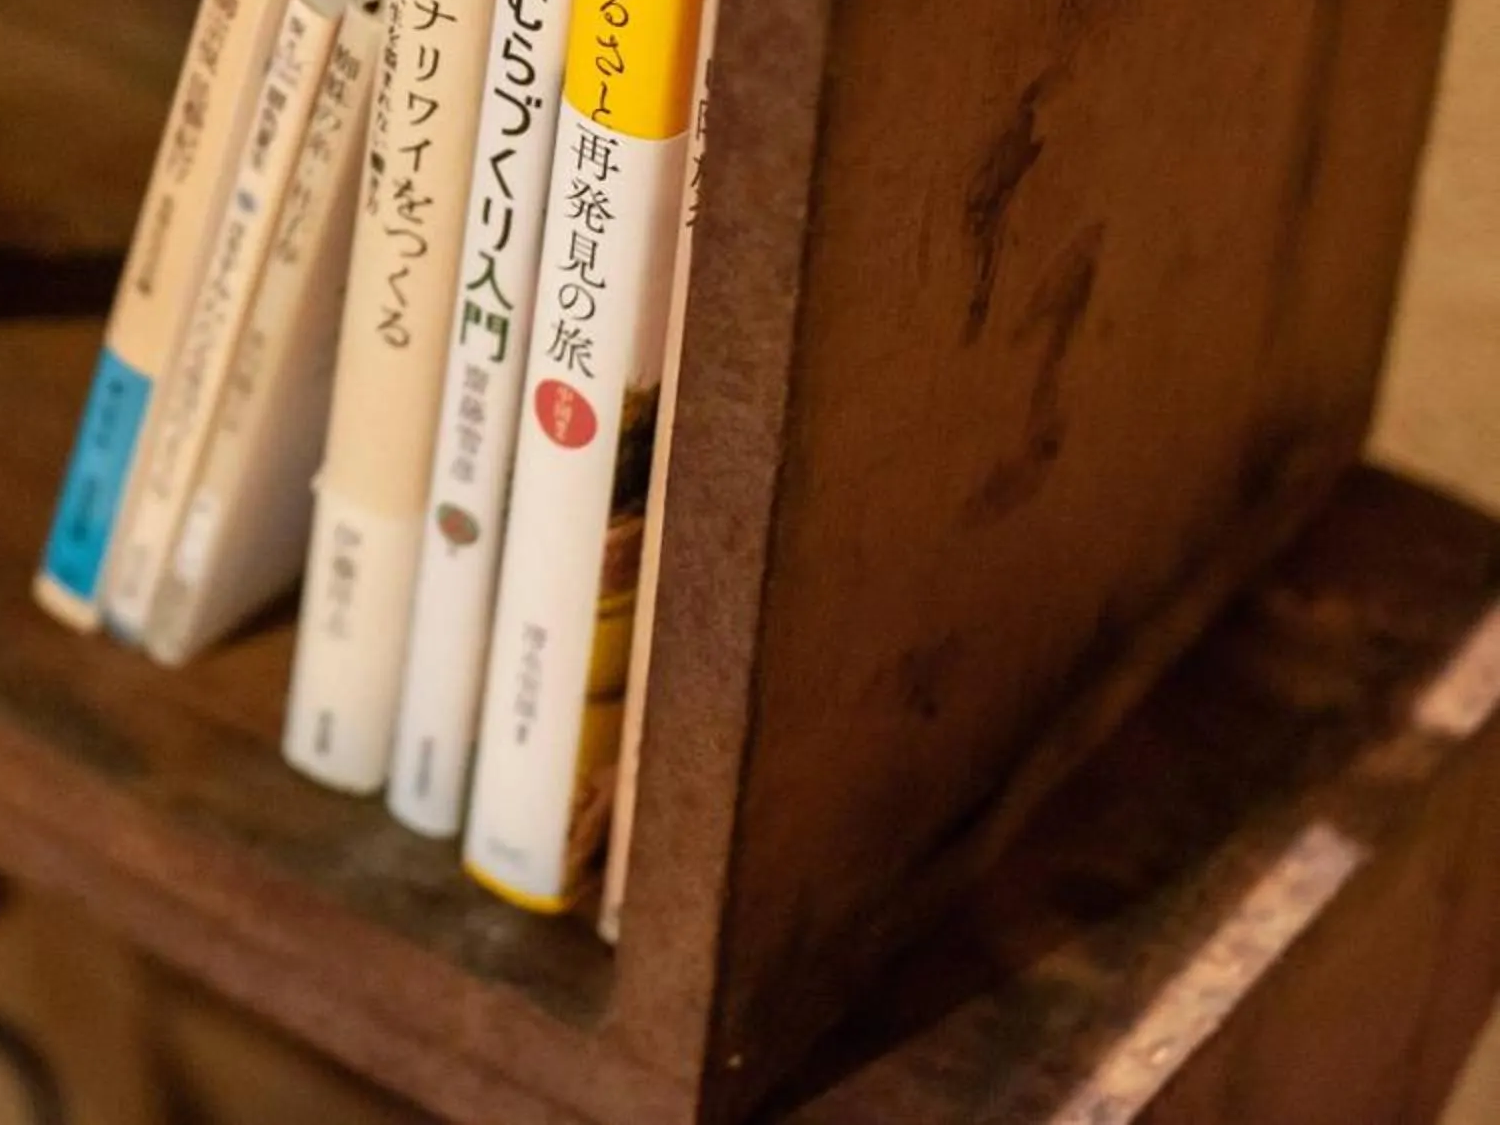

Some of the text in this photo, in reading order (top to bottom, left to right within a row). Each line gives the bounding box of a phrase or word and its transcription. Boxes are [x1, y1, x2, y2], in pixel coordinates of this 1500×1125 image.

[374, 0, 458, 350] ナリワイをつくる
